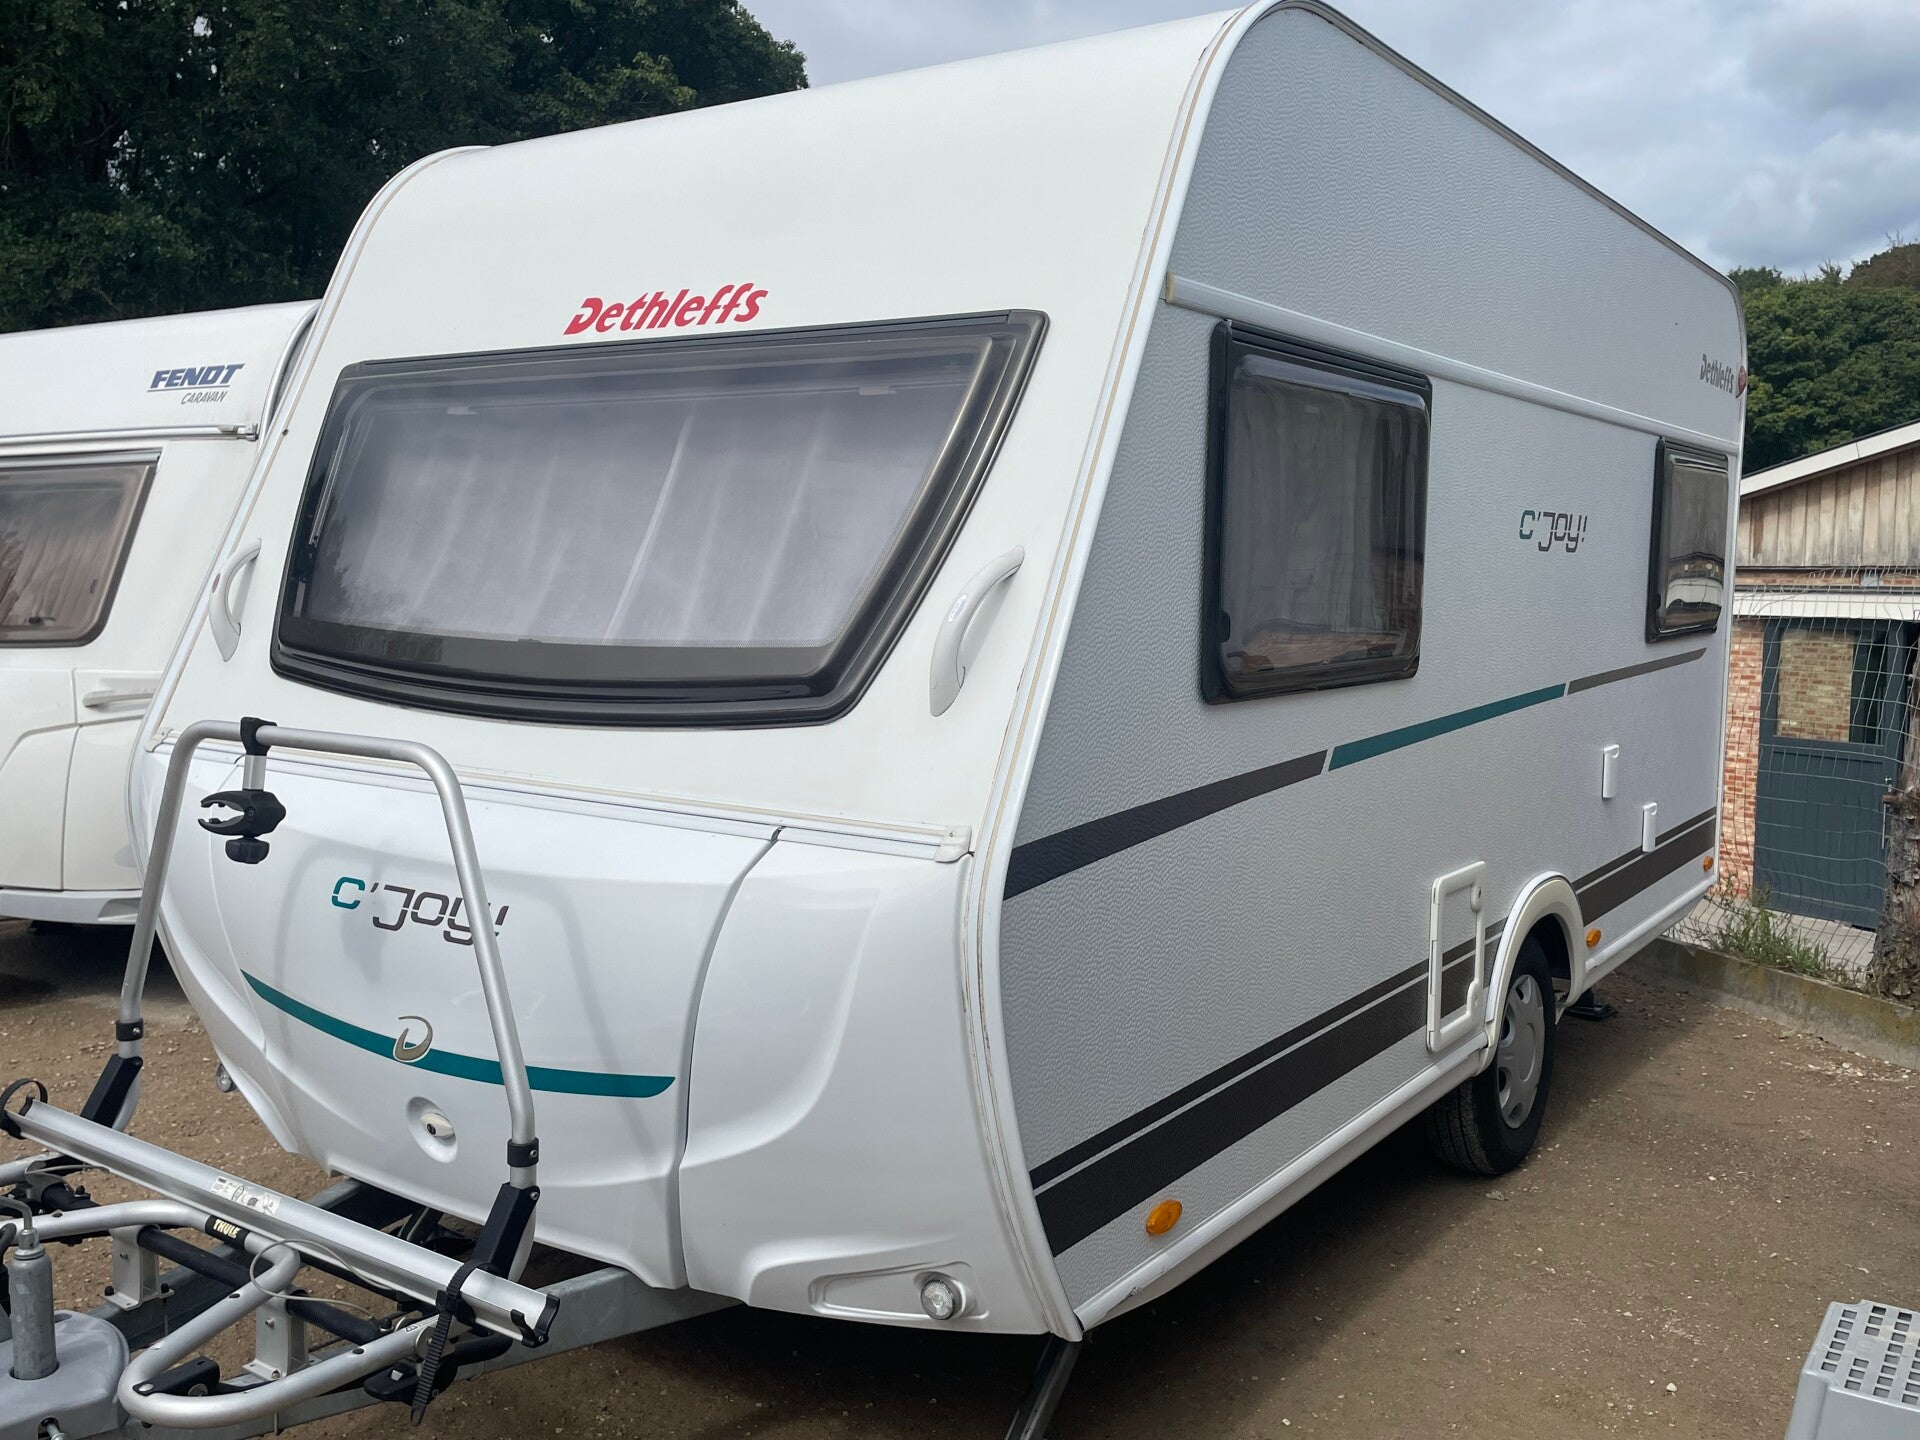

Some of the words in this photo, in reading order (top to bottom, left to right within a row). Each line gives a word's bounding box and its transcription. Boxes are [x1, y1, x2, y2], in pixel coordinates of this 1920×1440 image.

[563, 283, 769, 335] Dethleffs
[150, 363, 245, 388] FENDT
[1700, 353, 1734, 393] Dethleffs
[181, 391, 228, 405] CARAVAN
[213, 1219, 240, 1239] THULE
